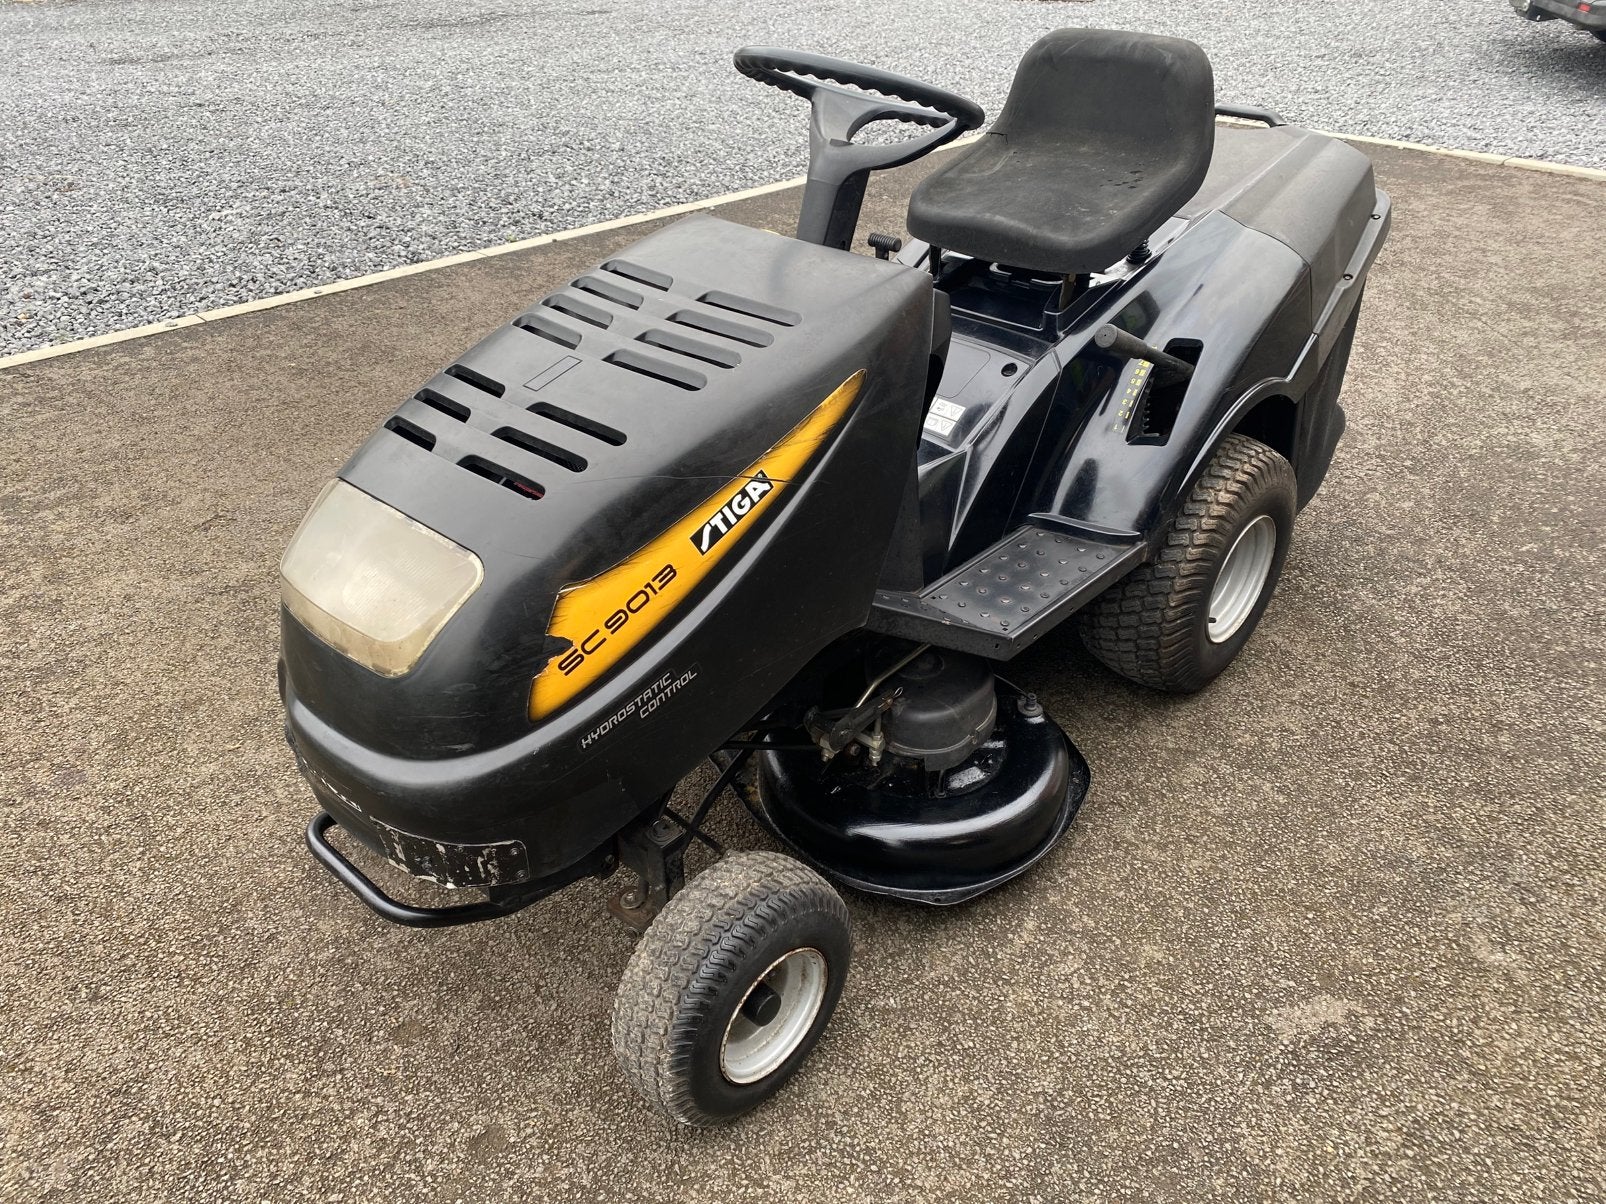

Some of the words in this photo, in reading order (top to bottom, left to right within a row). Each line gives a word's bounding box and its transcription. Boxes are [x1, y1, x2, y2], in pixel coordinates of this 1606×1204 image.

[700, 480, 771, 553] STIGA
[558, 629, 607, 676] SC
[604, 564, 677, 635] 9013
[581, 672, 672, 749] HYDROSTATIC
[640, 670, 698, 719] CONTROL
